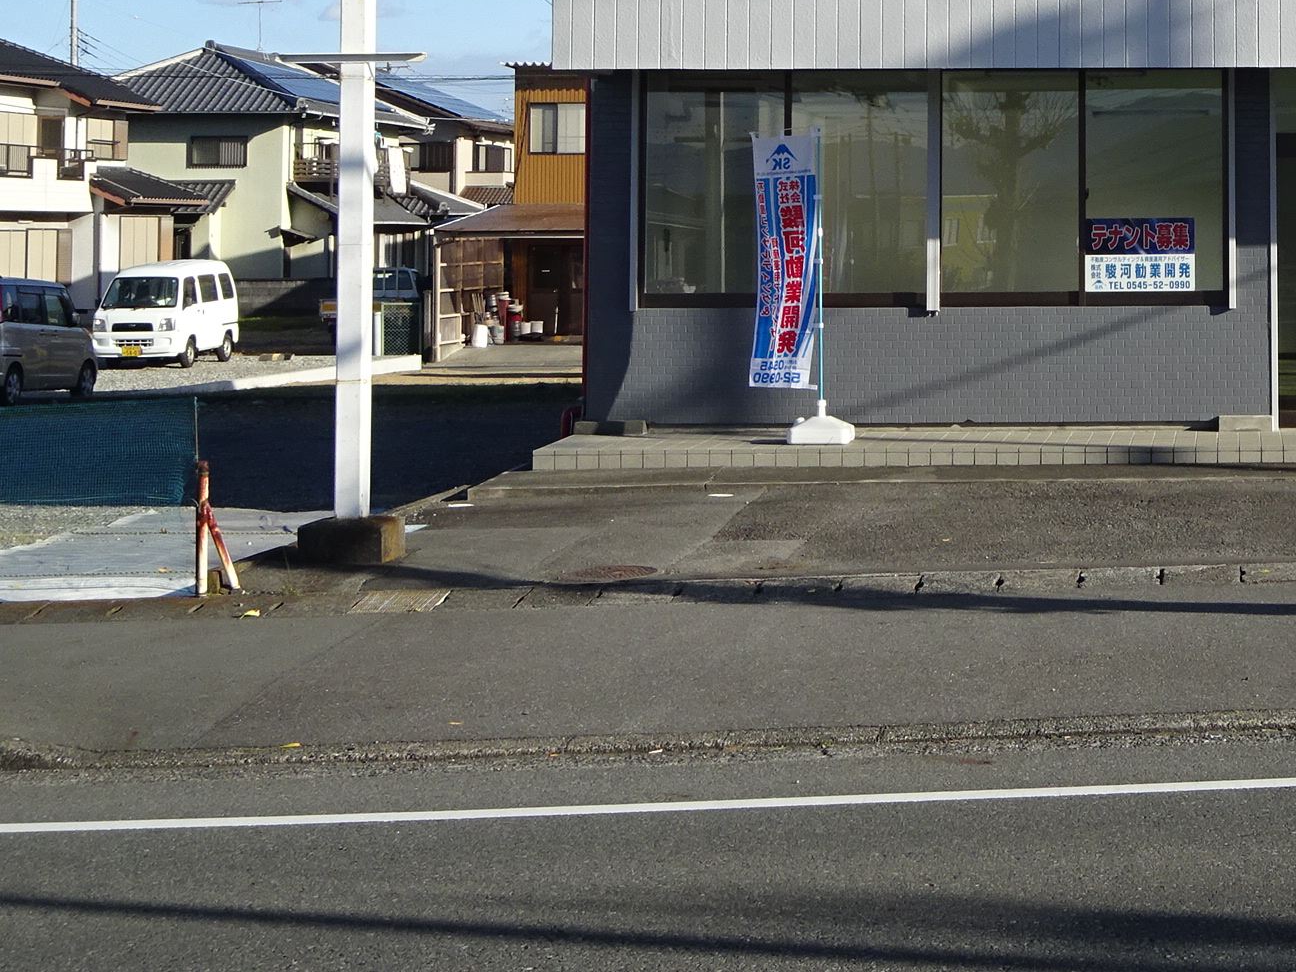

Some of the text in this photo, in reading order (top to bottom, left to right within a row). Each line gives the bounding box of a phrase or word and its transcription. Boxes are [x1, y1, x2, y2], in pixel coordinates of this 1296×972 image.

[1091, 222, 1190, 250] テナント募集
[1105, 263, 1190, 279] 駿河勧業開発
[1109, 280, 1190, 290] TEL 0545-52-0990
